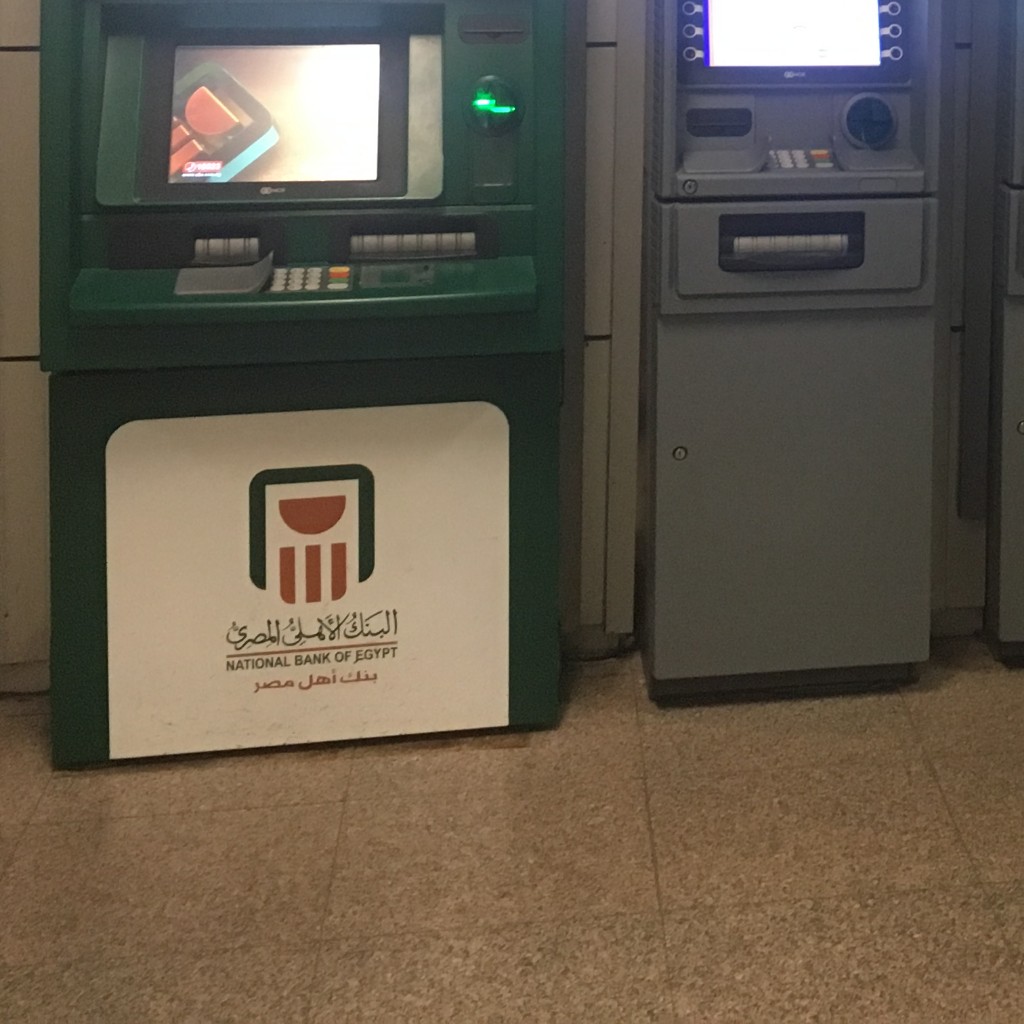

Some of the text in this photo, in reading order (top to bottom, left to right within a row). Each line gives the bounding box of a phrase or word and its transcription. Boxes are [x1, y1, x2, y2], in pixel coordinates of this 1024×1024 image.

[226, 646, 398, 672] NATIONAL BANK OF EGYPT
[339, 670, 378, 684] بنك
[253, 679, 295, 694] مصر
